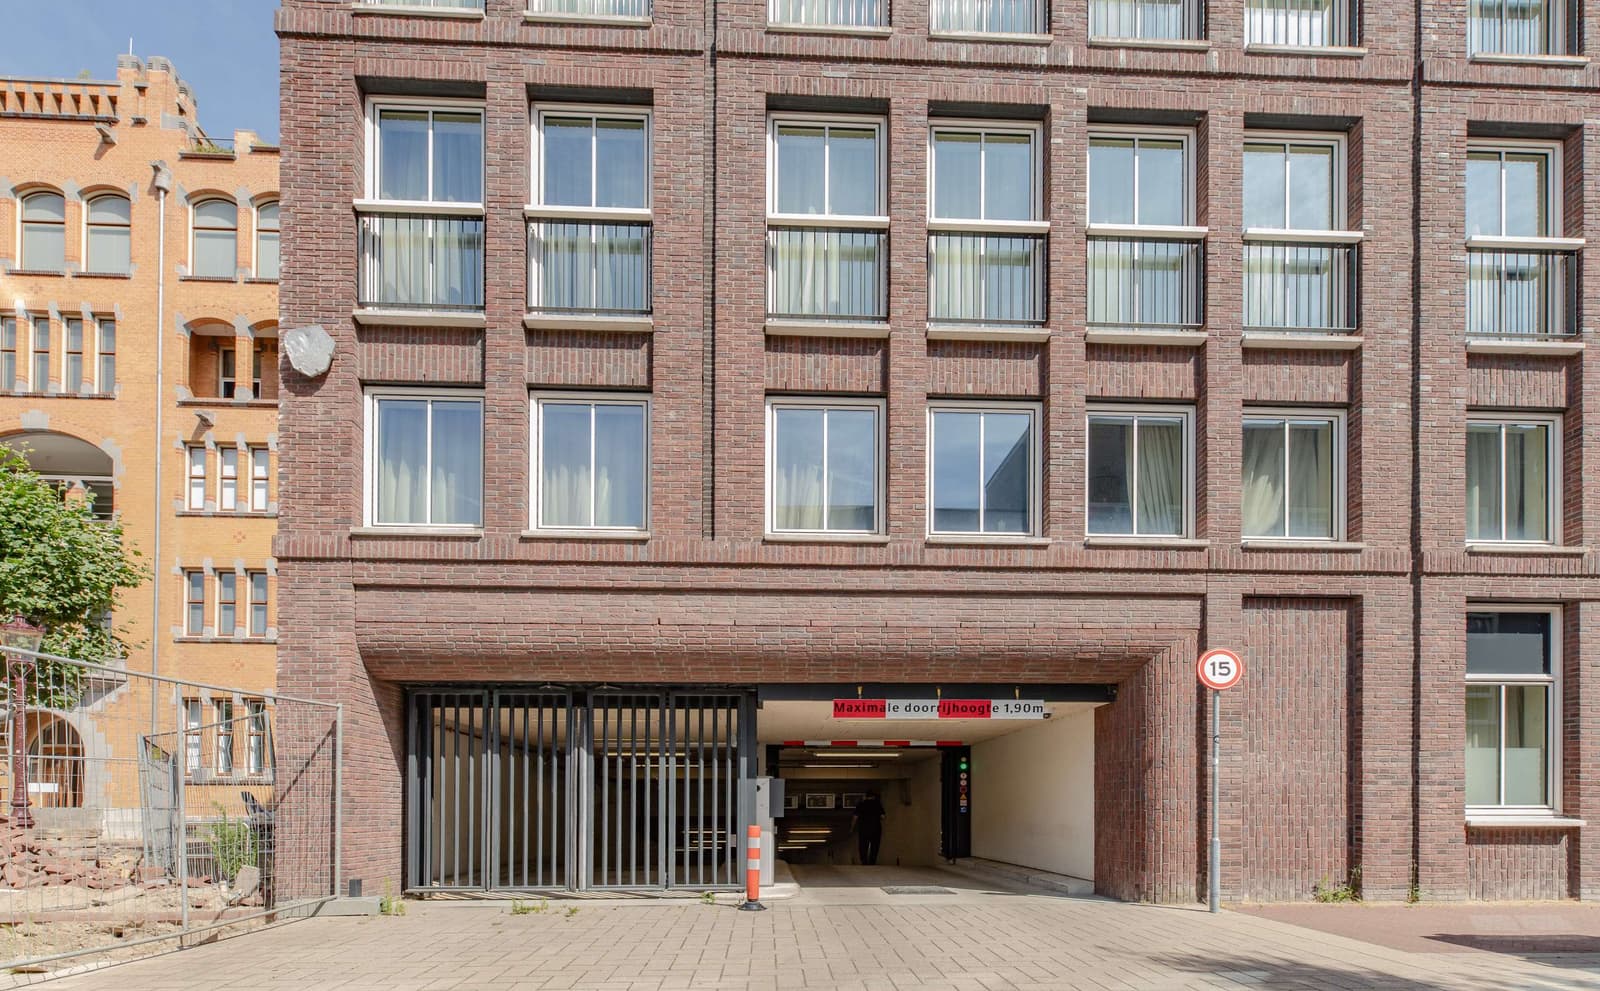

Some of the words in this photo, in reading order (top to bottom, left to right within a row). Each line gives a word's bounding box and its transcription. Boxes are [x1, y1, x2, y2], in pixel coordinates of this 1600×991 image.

[1210, 661, 1231, 676] 15
[834, 702, 899, 713] Maximale
[904, 703, 1000, 716] doorrijhoogte
[1003, 703, 1043, 714] 1,90m
